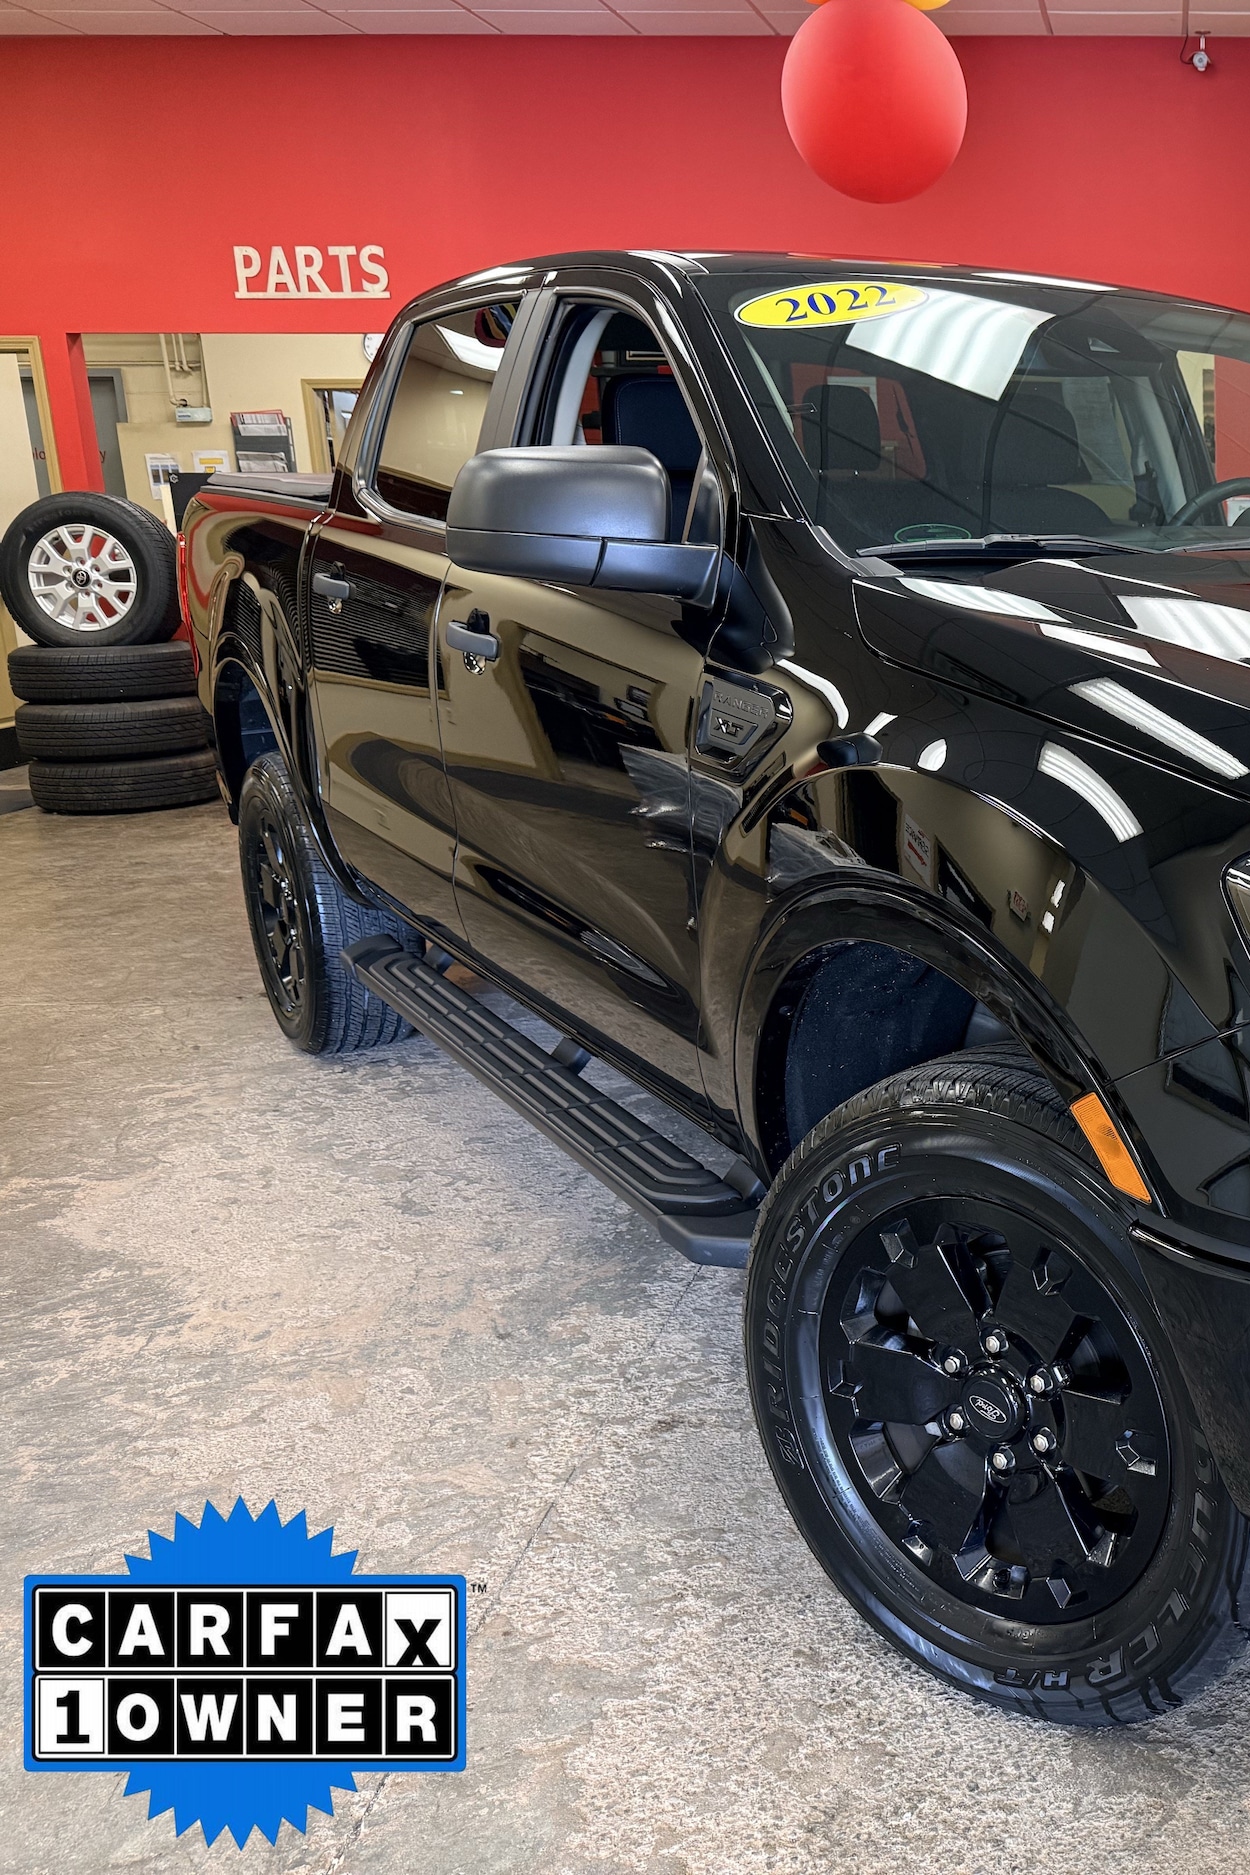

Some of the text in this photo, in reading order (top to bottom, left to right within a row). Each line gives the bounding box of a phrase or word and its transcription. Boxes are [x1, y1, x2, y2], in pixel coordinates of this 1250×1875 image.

[233, 245, 389, 296] PARTS
[775, 285, 896, 322] 2022
[714, 691, 769, 718] RANGER
[713, 717, 744, 738] XLT
[974, 1398, 1001, 1420] Ford
[998, 1667, 1070, 1687] H/T
